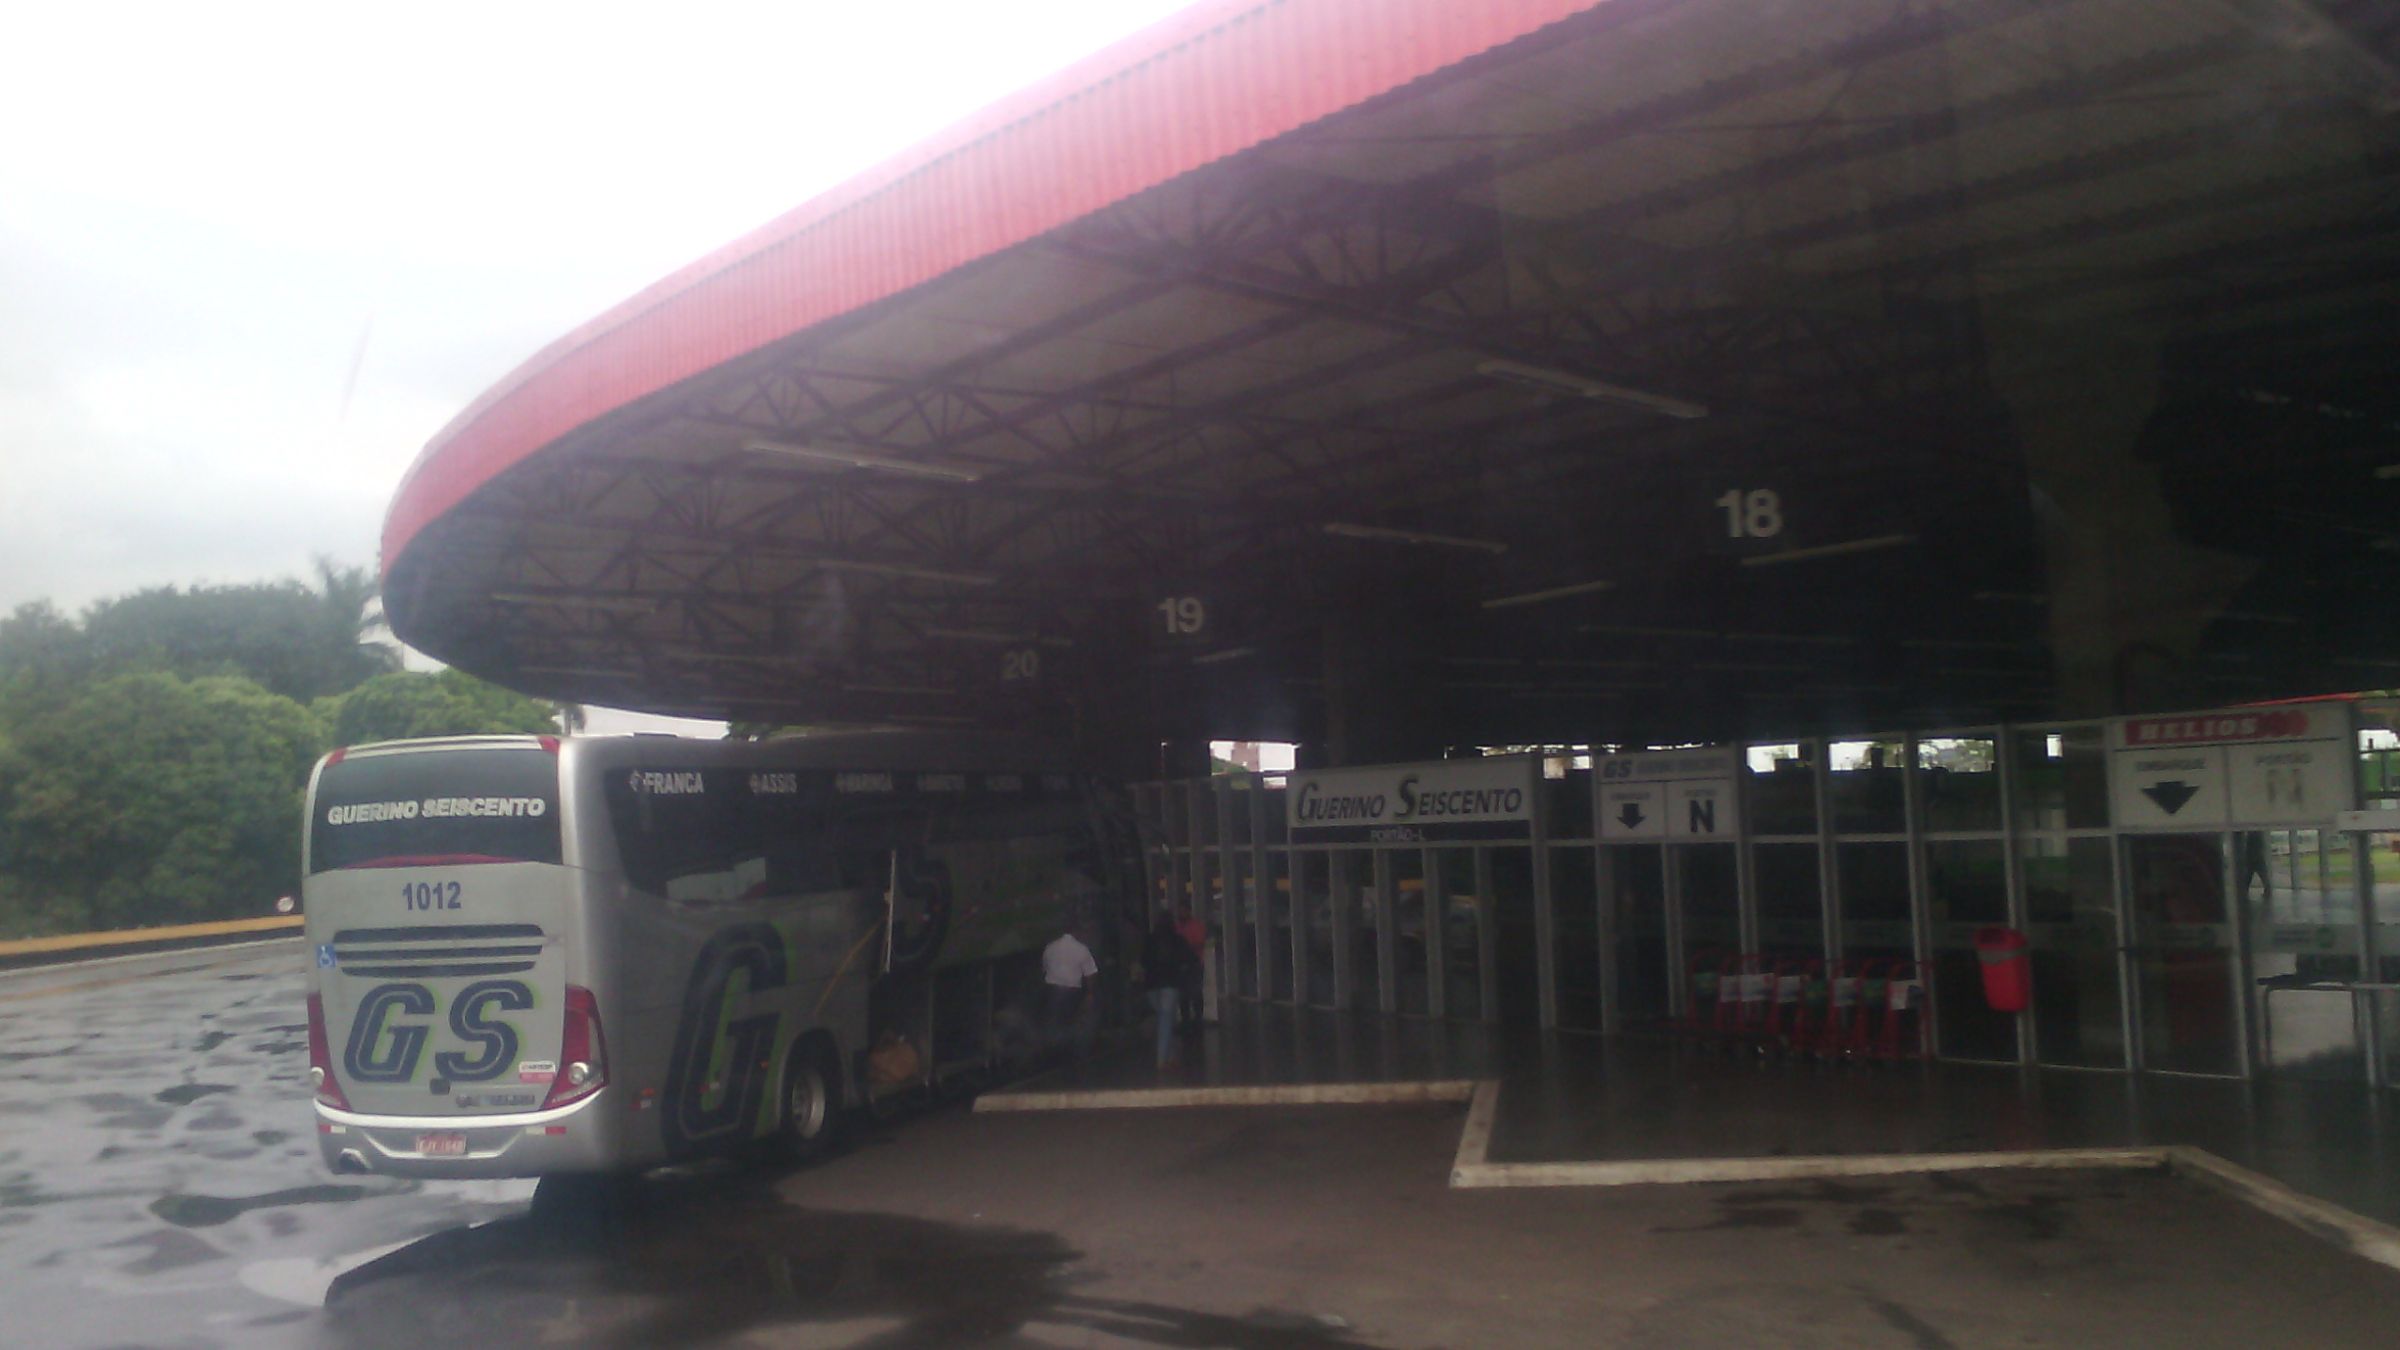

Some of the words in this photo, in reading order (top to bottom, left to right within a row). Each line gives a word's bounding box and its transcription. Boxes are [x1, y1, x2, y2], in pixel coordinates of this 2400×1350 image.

[1715, 489, 1783, 539] 18
[1158, 597, 1203, 634] 19
[1002, 650, 1040, 680] 20
[2140, 717, 2258, 740] HELIOS
[328, 800, 419, 825] GUERINO
[422, 798, 545, 818] SEISCENTO
[1690, 799, 1715, 833] N
[402, 881, 462, 911] 1012
[343, 979, 536, 1084] GS
